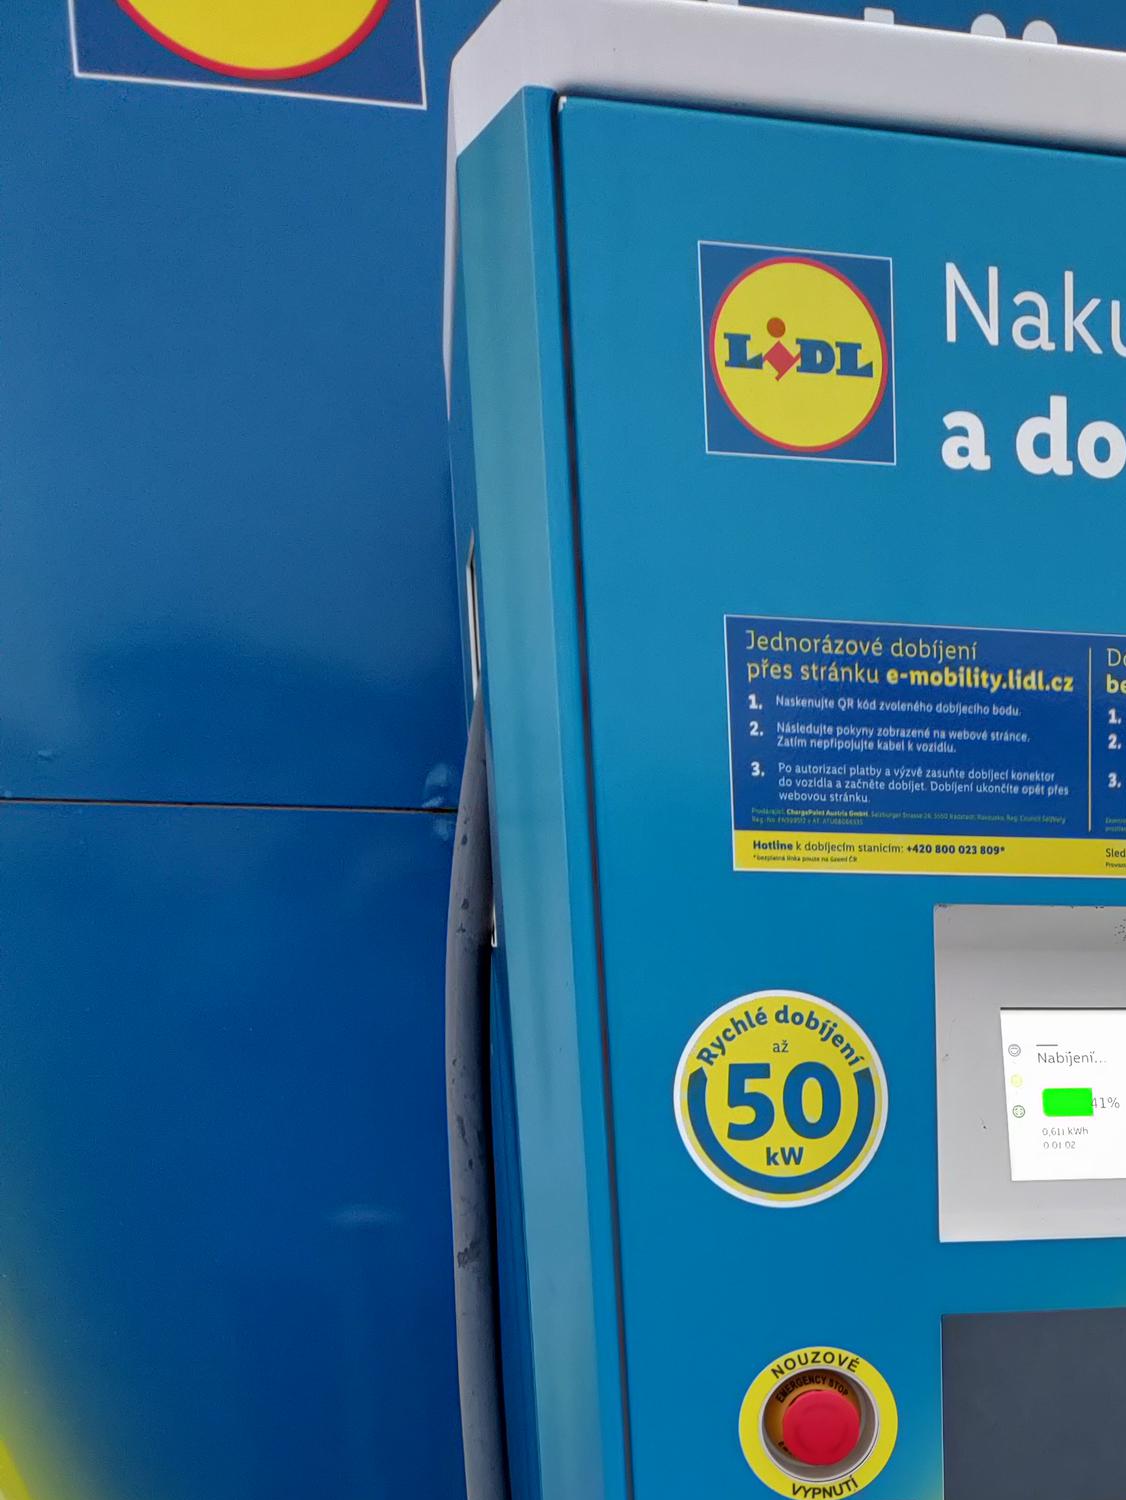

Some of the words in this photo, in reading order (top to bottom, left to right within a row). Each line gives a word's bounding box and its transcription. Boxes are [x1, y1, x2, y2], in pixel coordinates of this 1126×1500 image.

[940, 409, 991, 472] a
[746, 630, 882, 656] Jednorázové
[890, 638, 978, 663] dobíjení
[747, 661, 792, 683] přes
[801, 662, 879, 683] stránku
[886, 666, 1074, 692] e-mobility.lidl.cz
[748, 694, 763, 710] 1.
[776, 695, 834, 710] Naskenujte
[838, 698, 853, 711] QR
[857, 699, 876, 711] kód
[880, 700, 932, 712] zvoleného
[1108, 709, 1122, 725] 1.
[750, 722, 764, 737] 2.
[777, 722, 833, 736] Následujte
[837, 725, 874, 737] pokyny
[877, 725, 930, 738] zobrazené
[934, 731, 945, 739] na
[948, 729, 987, 741] webové
[777, 736, 806, 748] Zatím
[810, 738, 874, 752] nepřipojujte
[877, 739, 904, 751] kabel
[907, 741, 914, 751] k
[916, 742, 956, 753] vozidlu.
[1108, 734, 1122, 750] 2.
[751, 762, 765, 778] 3.
[778, 763, 792, 773] Po
[795, 764, 847, 775] autorizaci
[850, 764, 881, 777] platby
[885, 768, 891, 776] a
[893, 767, 923, 779] výzvě
[1011, 770, 1055, 783] konektor
[1108, 773, 1122, 789] 3.
[778, 776, 792, 787] do
[796, 777, 833, 788] vozidla
[835, 780, 842, 788] a
[845, 779, 885, 790] začněte
[1022, 784, 1045, 796] opět
[1047, 784, 1069, 797] přes
[779, 791, 826, 801] webovou
[752, 839, 793, 851] Hotline
[795, 841, 802, 851] k
[804, 841, 855, 853] dobíjecím
[906, 844, 932, 854] +420
[935, 844, 956, 854] 800
[958, 845, 977, 855] 023
[696, 1006, 768, 1066] Rychlé
[774, 1004, 865, 1066] dobíjení
[772, 1040, 789, 1053] až
[727, 1061, 842, 1141] 50
[1067, 1126, 1089, 1136] kWh
[766, 1146, 804, 1166] kW
[771, 1350, 861, 1379] NOUZOVÉ
[775, 1375, 827, 1403] EMERGENCY
[828, 1378, 849, 1396] STOP
[791, 1474, 859, 1499] VYPNUTÍ
